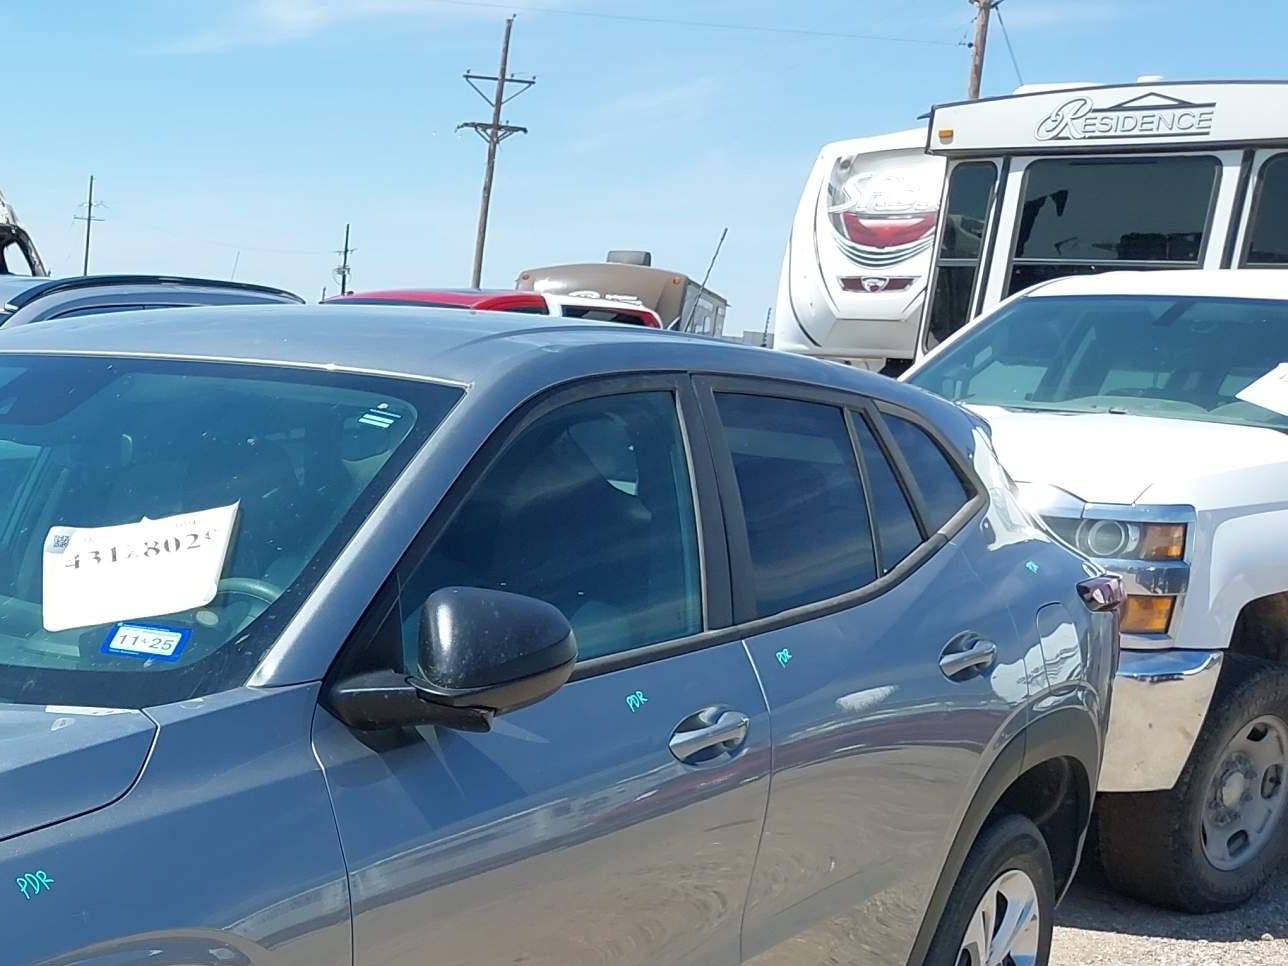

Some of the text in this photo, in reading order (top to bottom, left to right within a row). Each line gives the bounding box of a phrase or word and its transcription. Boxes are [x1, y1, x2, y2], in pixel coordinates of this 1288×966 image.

[1034, 96, 1214, 141] RESIDENCE
[626, 690, 649, 713] PDR
[16, 870, 55, 900] PDR
